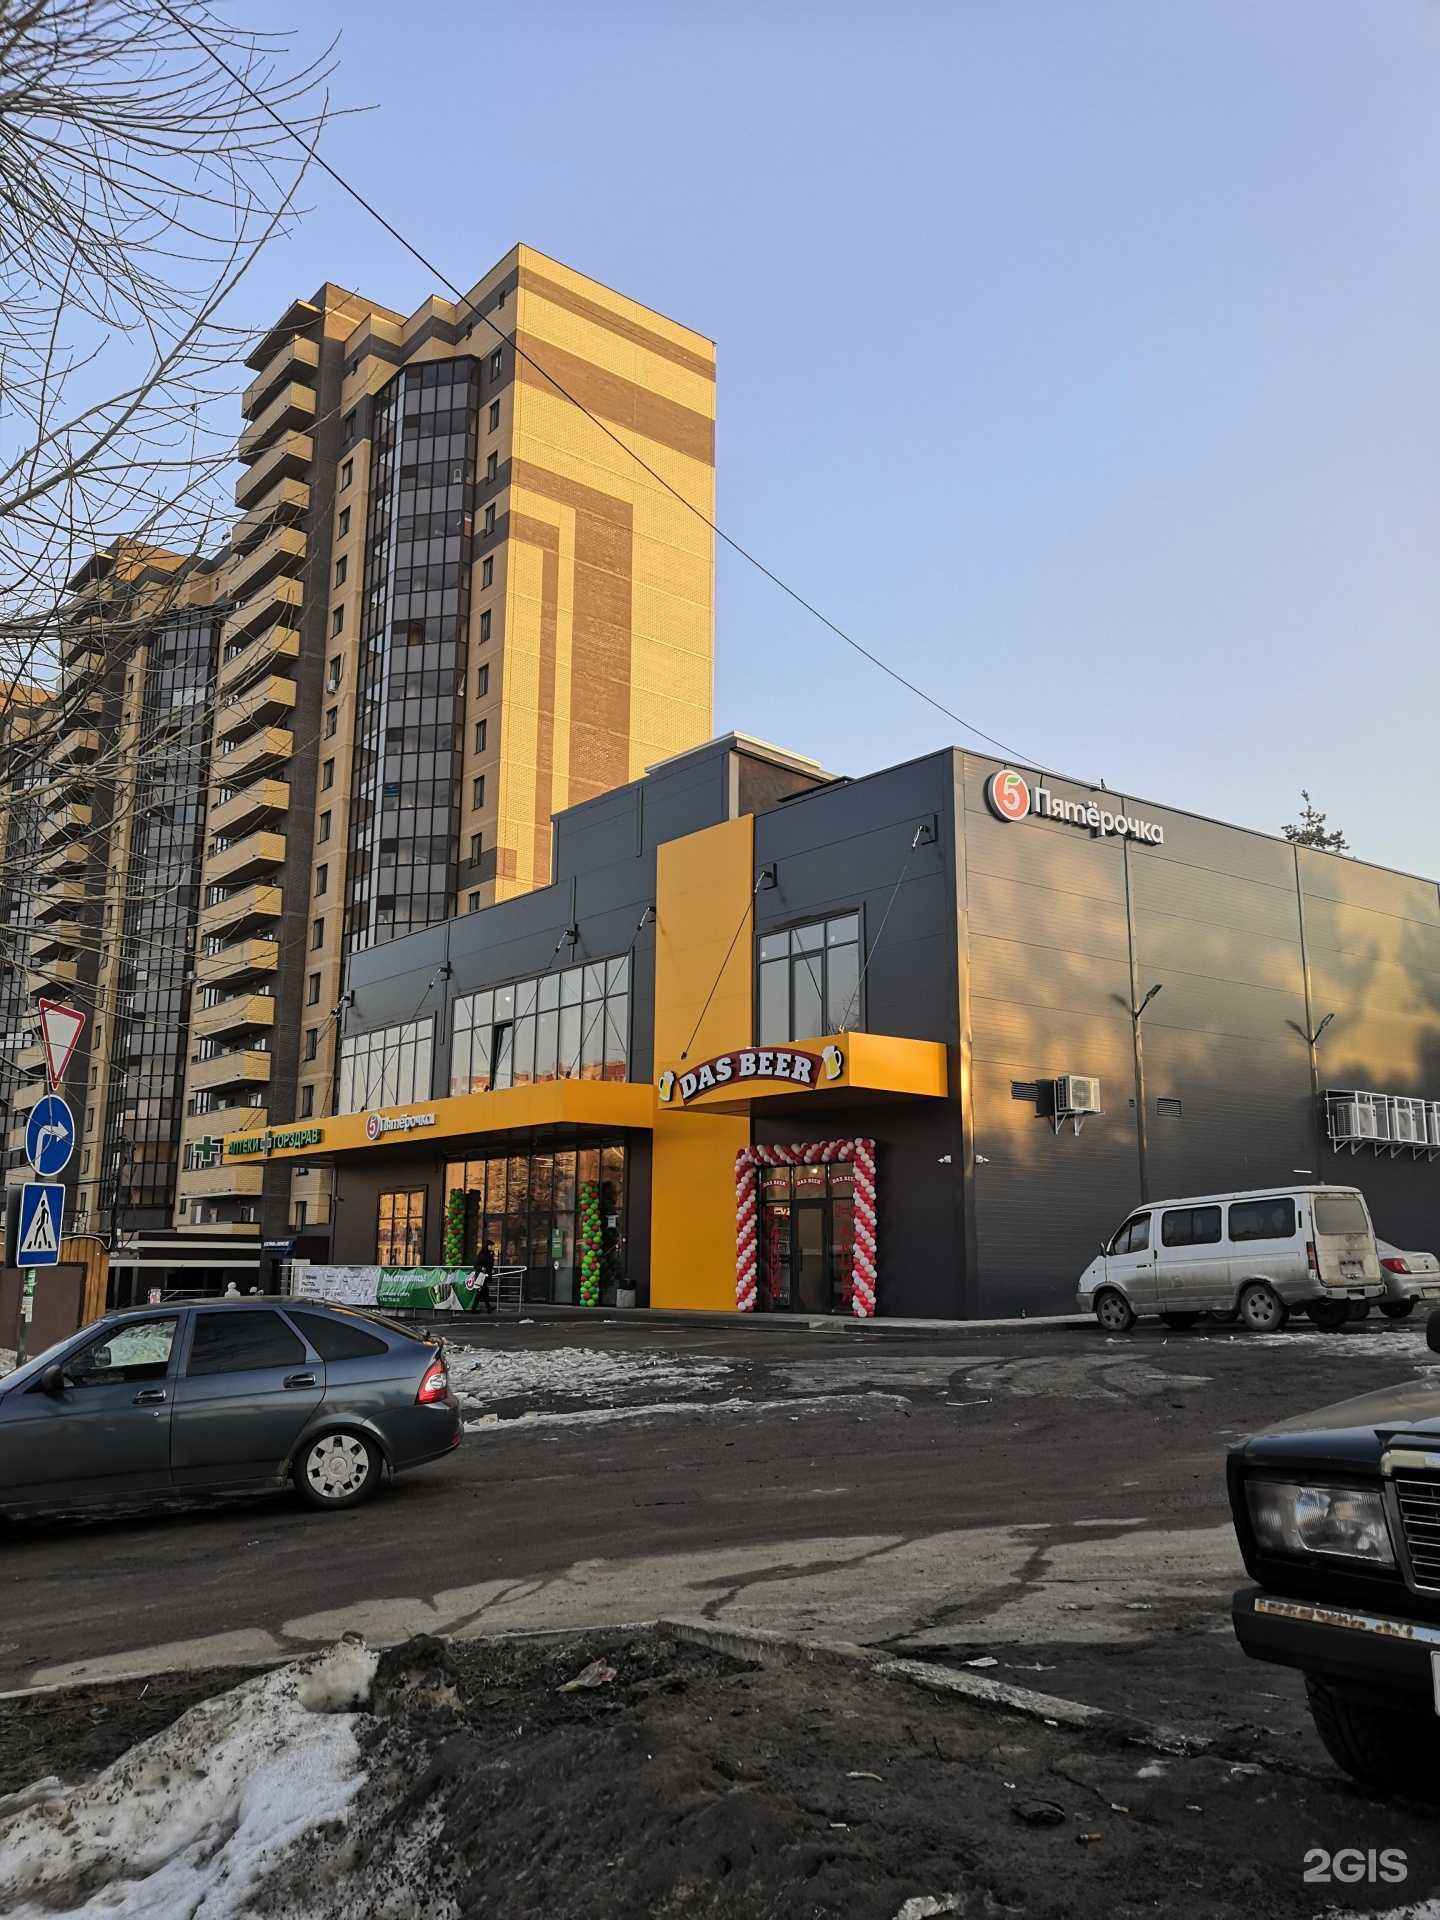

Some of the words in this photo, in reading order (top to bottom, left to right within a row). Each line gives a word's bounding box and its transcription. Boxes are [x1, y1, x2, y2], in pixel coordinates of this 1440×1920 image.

[1035, 787, 1164, 844] Пятёрочка
[679, 1057, 732, 1100] DAS
[738, 1052, 812, 1083] BEER
[380, 1113, 435, 1132] Пятёрочка
[228, 1137, 260, 1155] АПТЕКИ
[272, 1128, 320, 1149] ГОРЗДРАВ
